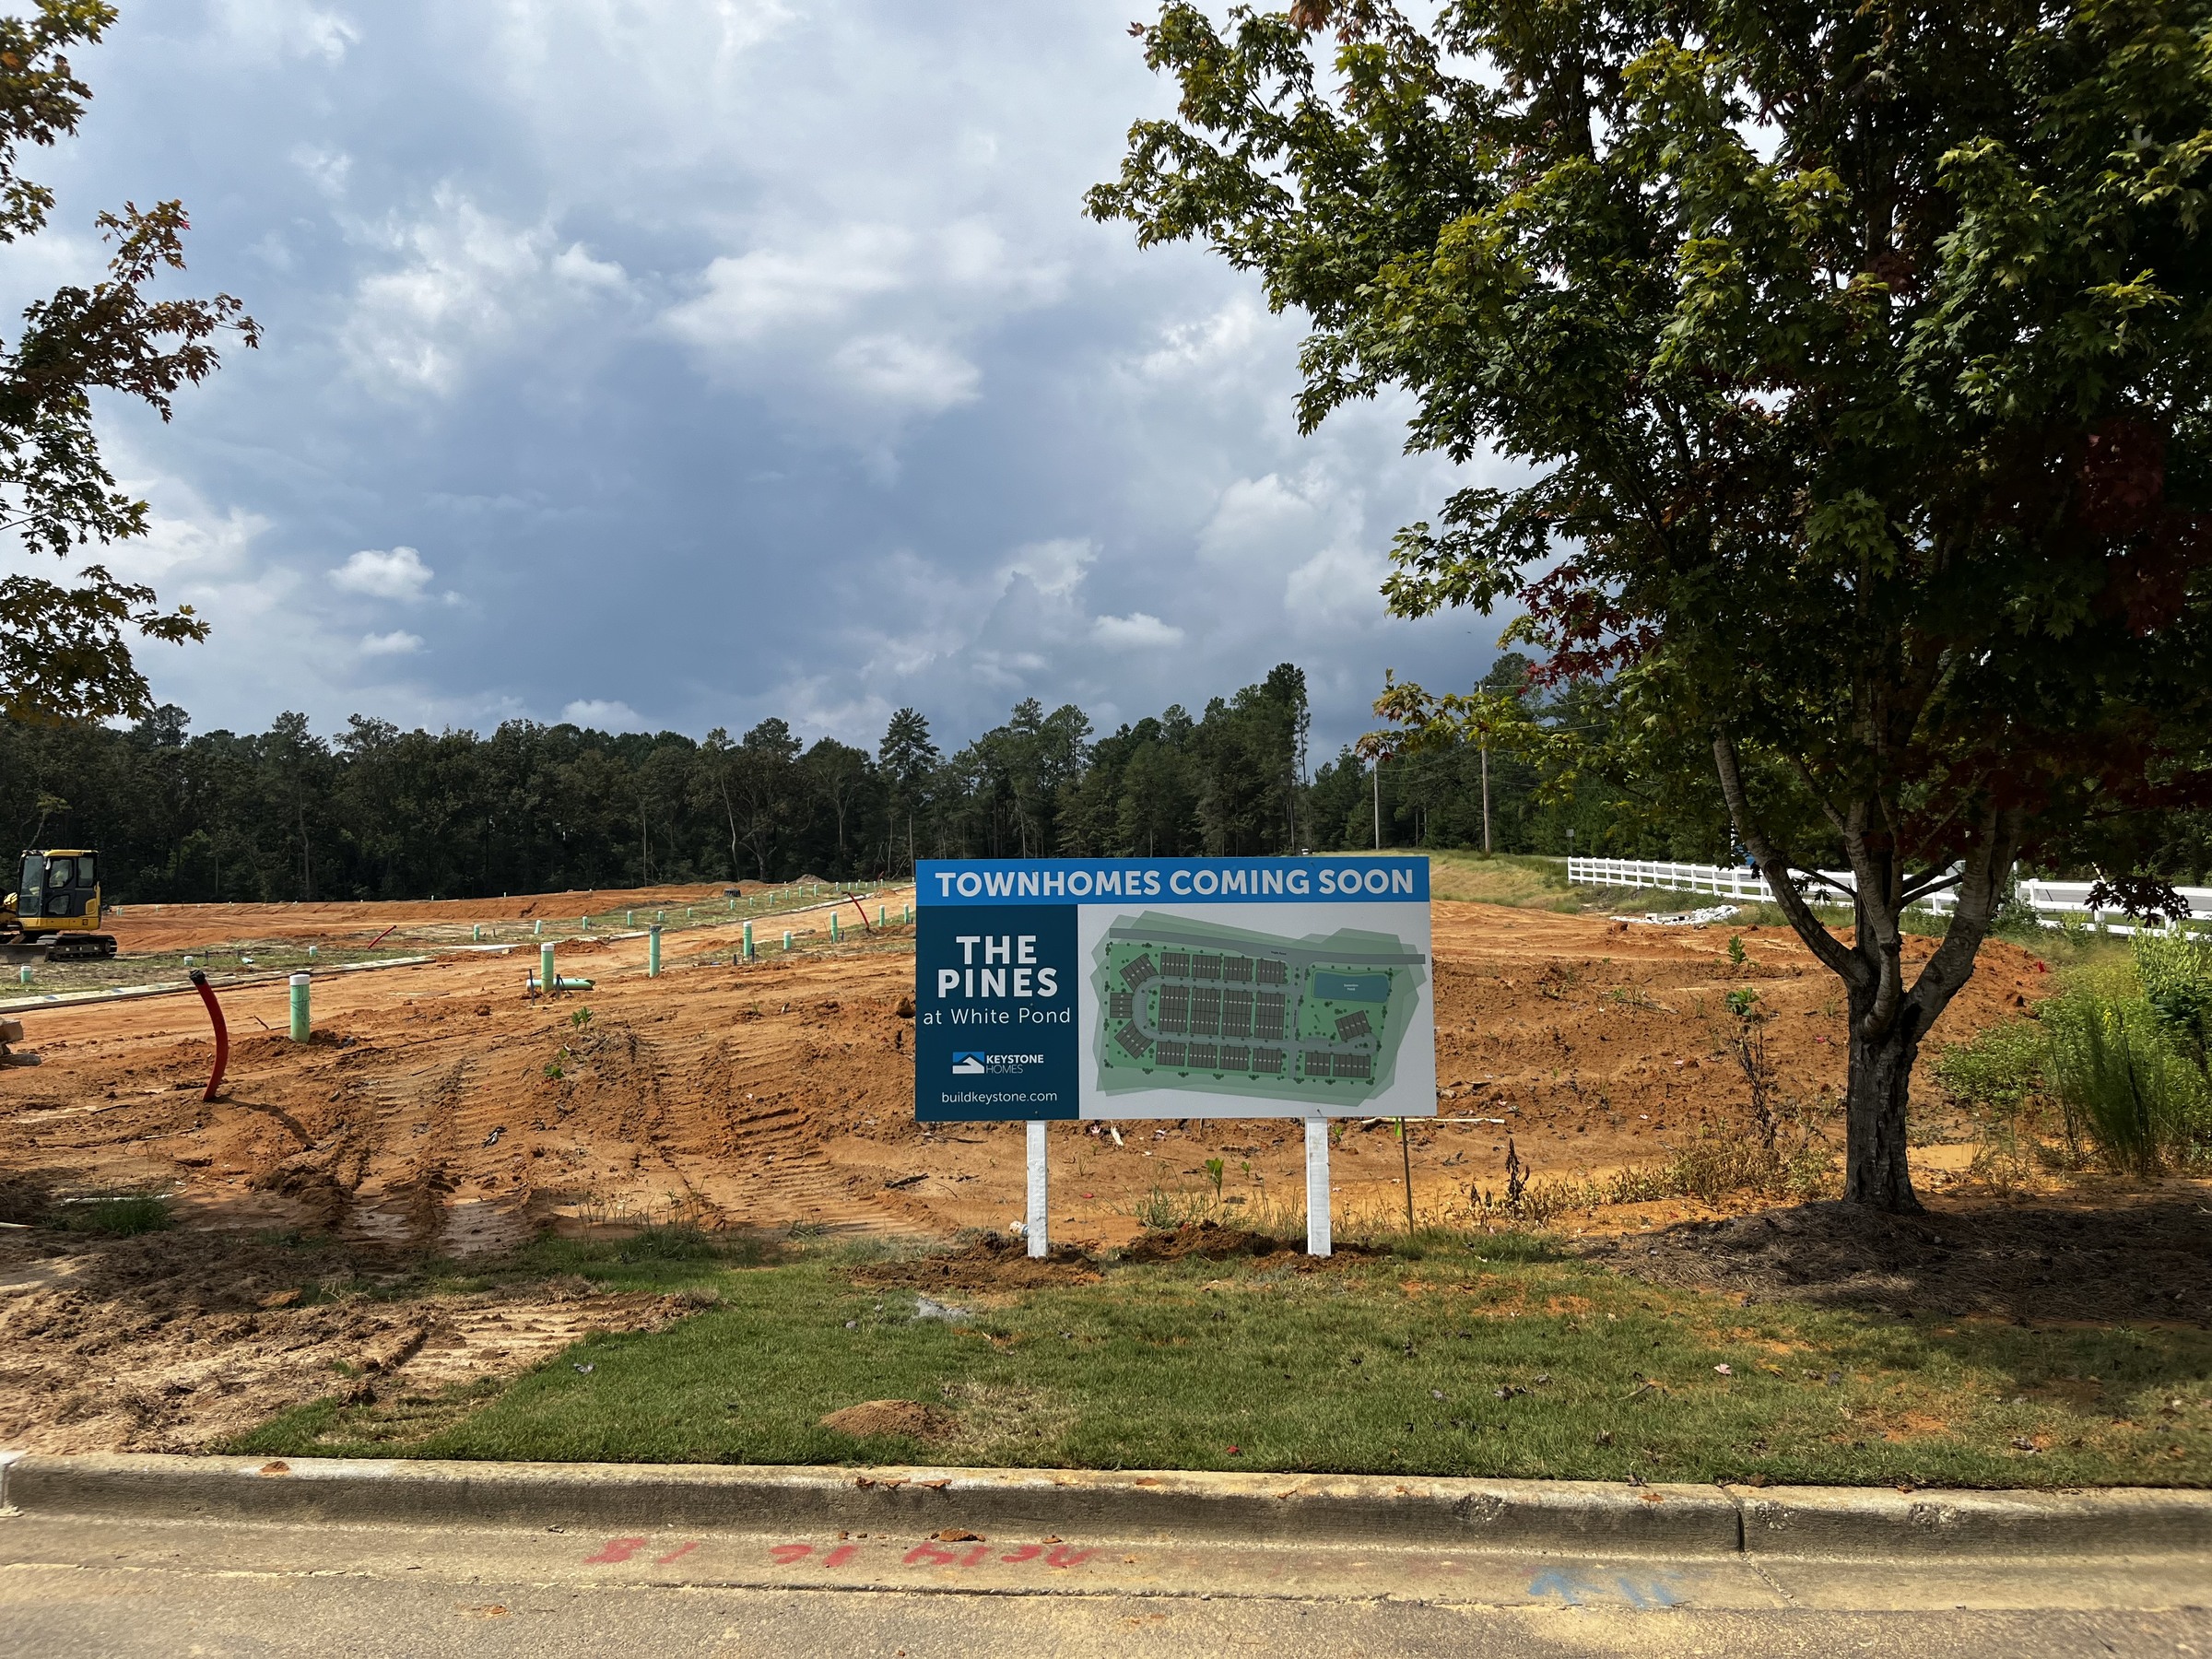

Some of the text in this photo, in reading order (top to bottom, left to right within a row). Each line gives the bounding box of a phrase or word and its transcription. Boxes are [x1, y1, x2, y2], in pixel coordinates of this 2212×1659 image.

[935, 868, 1413, 898] TOWNHOMES COMING SOON
[956, 935, 1037, 965] THE
[937, 968, 1058, 998] PINES
[923, 1007, 1070, 1025] at White Pond
[986, 1054, 1044, 1065] KEYSTONE
[985, 1065, 1024, 1074] HOMES
[941, 1091, 1057, 1105] buildkeystone.com
